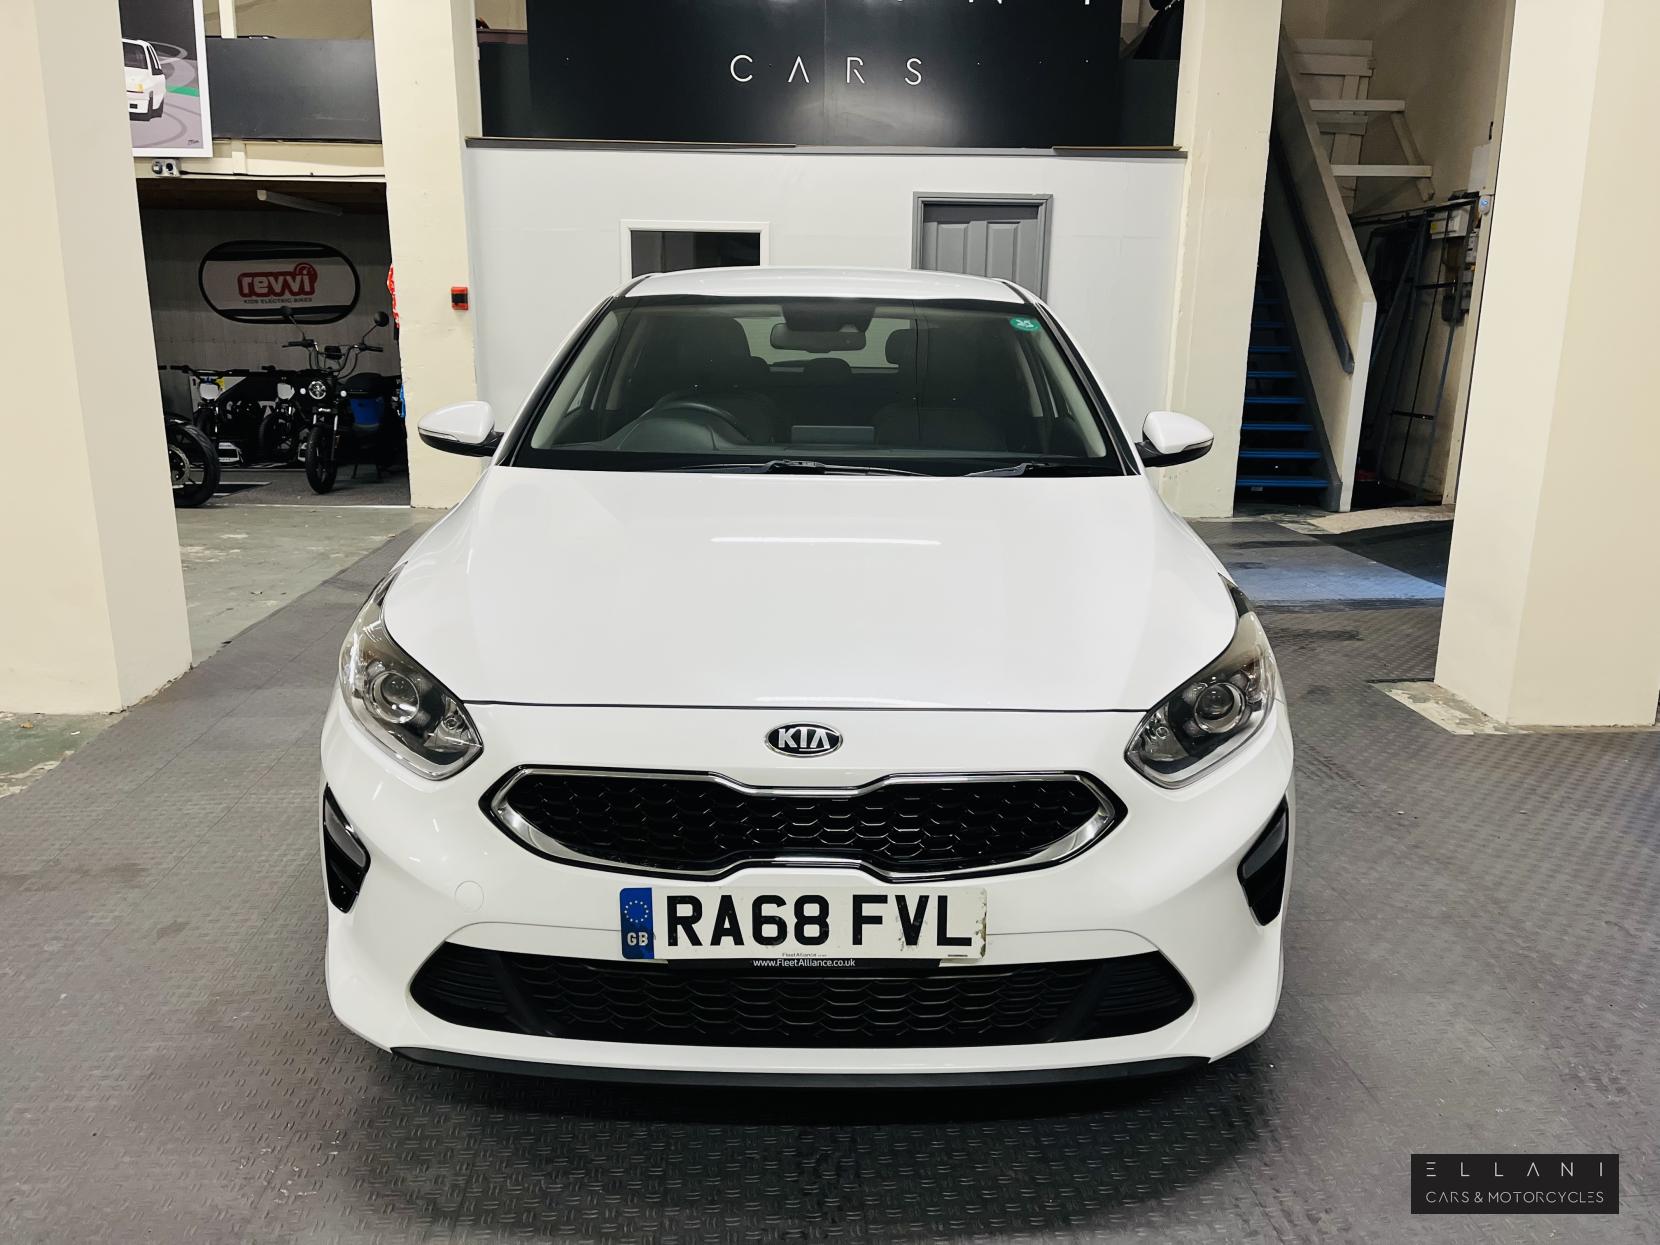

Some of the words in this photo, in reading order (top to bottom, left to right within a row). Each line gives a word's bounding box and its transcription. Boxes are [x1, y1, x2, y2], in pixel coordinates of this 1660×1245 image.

[730, 55, 922, 86] CARS
[240, 268, 311, 294] revvi
[778, 727, 831, 750] KIA
[666, 894, 830, 946] RA68
[851, 894, 972, 946] FVL
[627, 932, 649, 946] GB
[753, 958, 856, 967] www.FleetAlliance.co.uk
